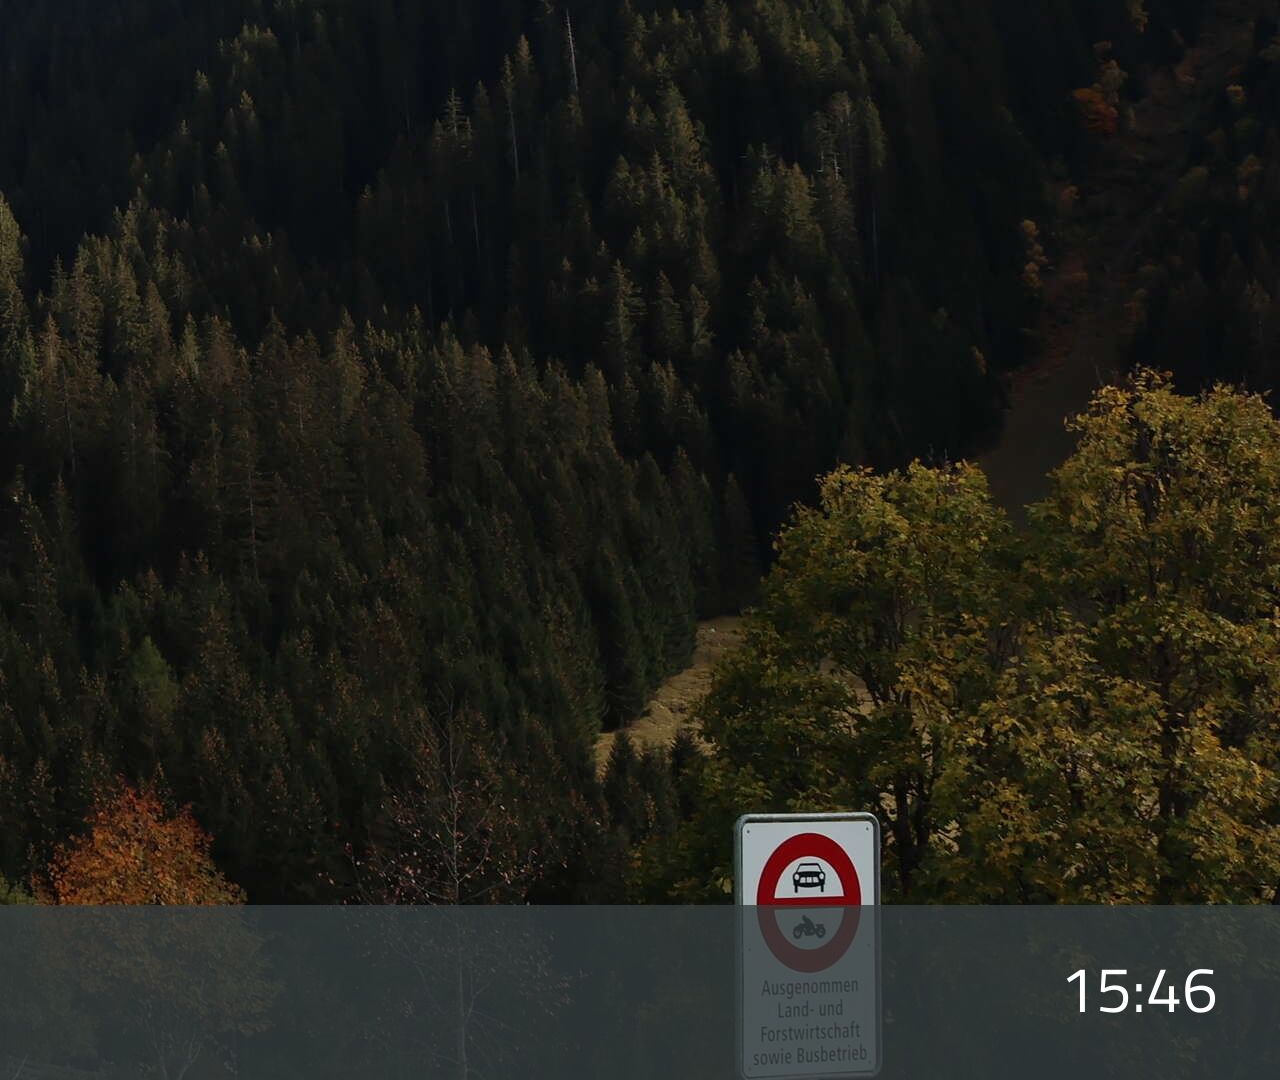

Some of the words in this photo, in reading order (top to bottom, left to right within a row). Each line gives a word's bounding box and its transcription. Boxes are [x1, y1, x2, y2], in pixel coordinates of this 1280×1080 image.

[761, 978, 859, 1000] Ausgenommen
[777, 1001, 814, 1019] Land-
[819, 999, 844, 1017] und
[760, 1021, 860, 1043] Forstwirtschaft
[753, 1049, 792, 1066] sowie
[797, 1045, 867, 1065] Busbetrieb
